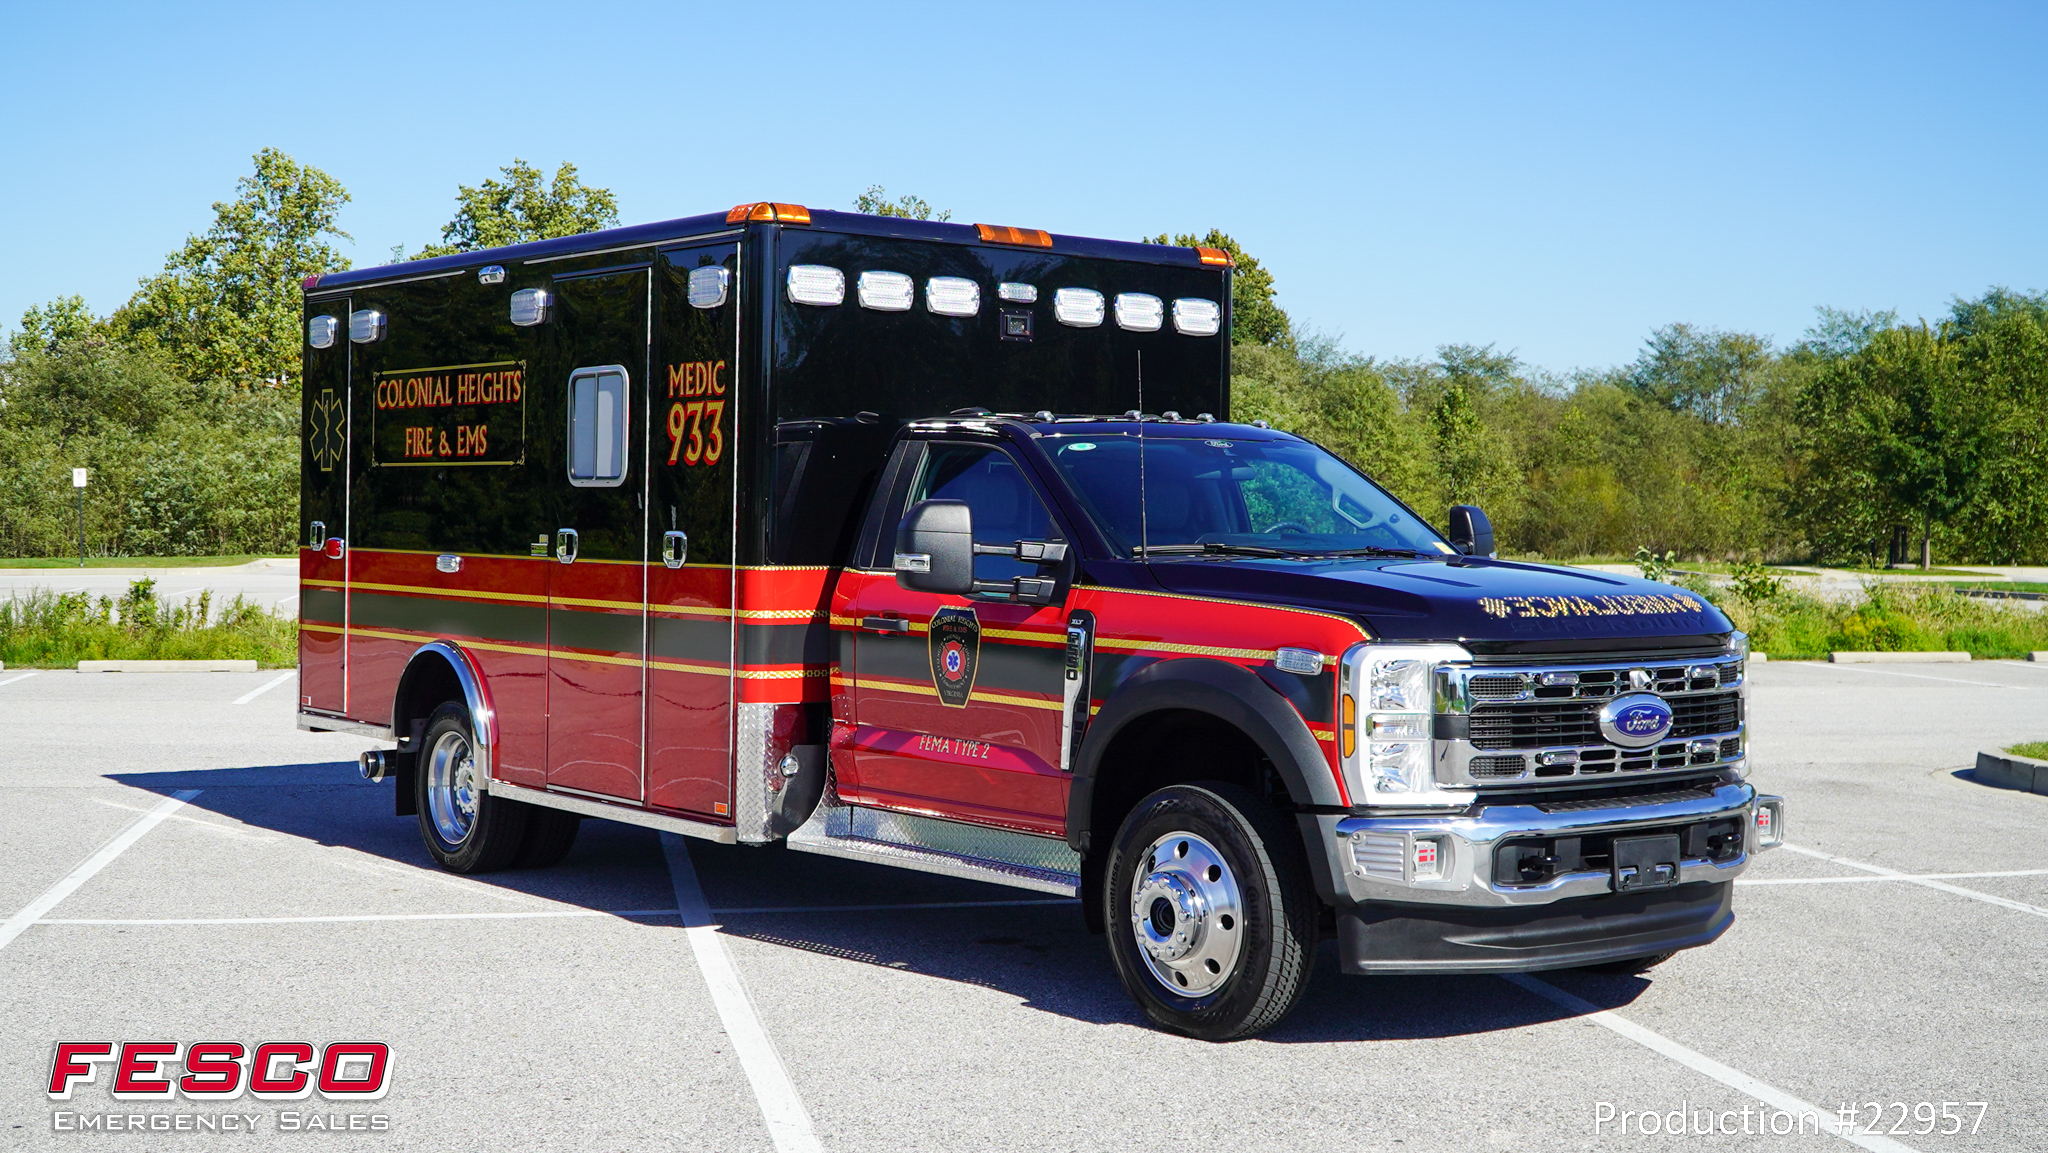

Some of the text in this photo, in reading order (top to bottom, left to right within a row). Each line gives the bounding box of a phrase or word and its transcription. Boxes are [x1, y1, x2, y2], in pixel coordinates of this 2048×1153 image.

[377, 370, 522, 410] COLONIAL HEIGHTS
[668, 360, 726, 398] MEDIC
[404, 424, 488, 457] FIRE & EMS
[666, 399, 725, 466] 933
[1627, 709, 1660, 731] Ford
[919, 734, 990, 759] FEMA TYPE 2
[1115, 854, 1122, 862] 5
[1111, 863, 1120, 887] HSR
